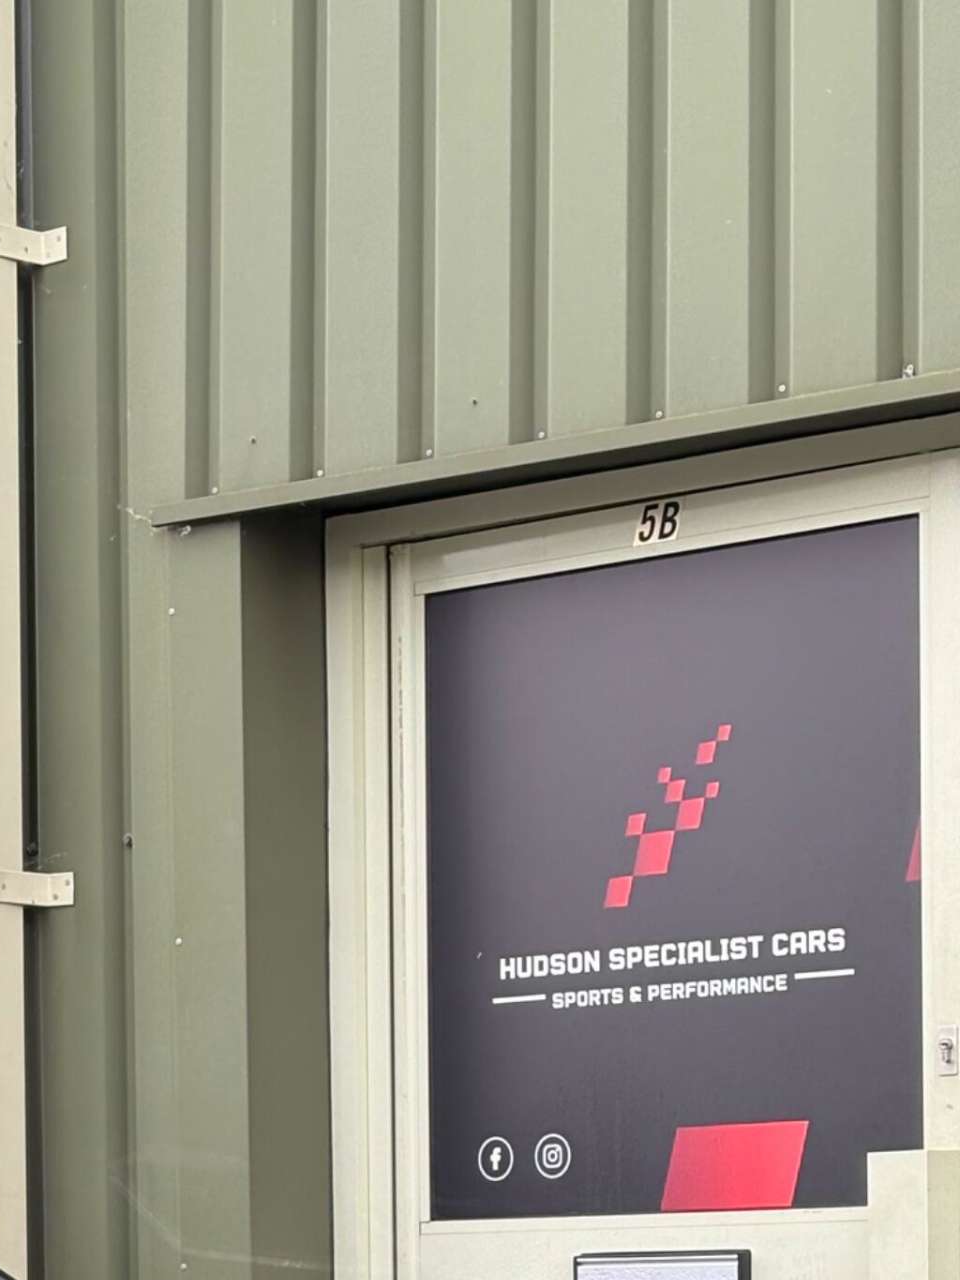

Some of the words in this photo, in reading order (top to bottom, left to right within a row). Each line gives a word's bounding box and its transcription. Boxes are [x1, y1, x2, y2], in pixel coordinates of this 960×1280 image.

[638, 501, 680, 543] 5B
[499, 950, 601, 981] HUDSON
[608, 935, 764, 970] SPECIALIST
[772, 927, 846, 957] CARS
[551, 987, 624, 1009] SPORTS
[629, 986, 642, 1003] &
[647, 973, 788, 1002] PERFORMANCE
